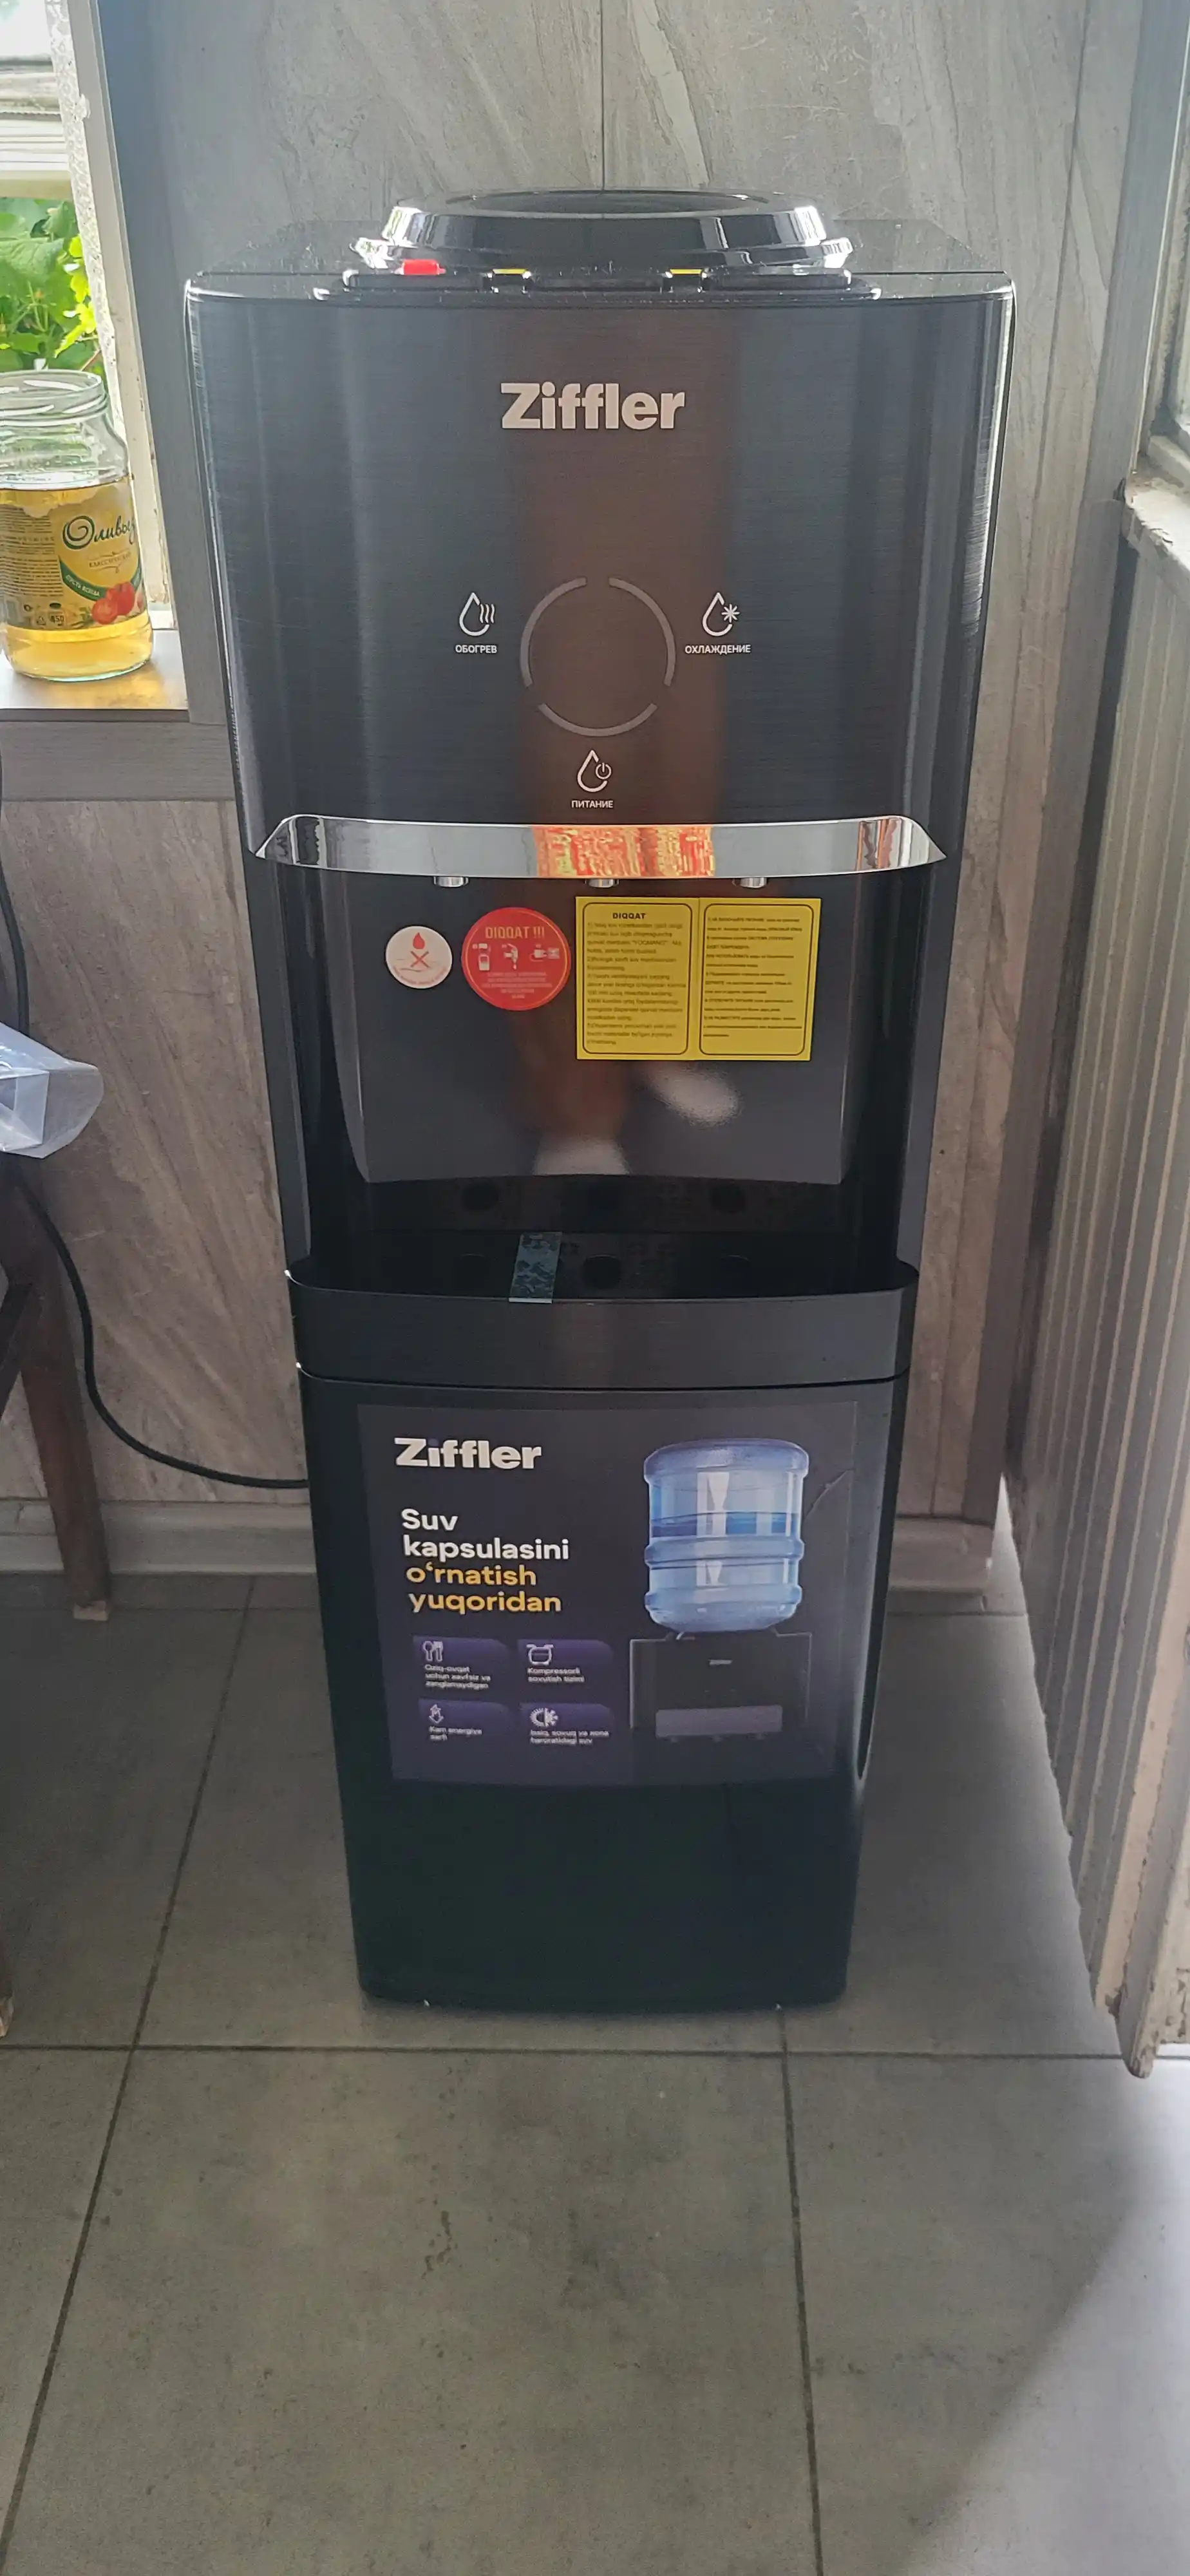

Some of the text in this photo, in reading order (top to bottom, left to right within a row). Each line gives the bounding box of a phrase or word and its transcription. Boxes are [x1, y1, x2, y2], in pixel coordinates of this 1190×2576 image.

[501, 381, 685, 430] Ziffler
[455, 644, 498, 654] ОБОГРЕВ
[685, 644, 751, 655] ОХЛАЖДЕНИЕ
[571, 800, 614, 808] ПИТАНИЕ
[485, 926, 530, 939] DIQQAT
[394, 1437, 542, 1470] Ziffler
[401, 1508, 458, 1531] Suv
[402, 1534, 569, 1562] kapsulasini
[408, 1591, 562, 1615] yuqoridan
